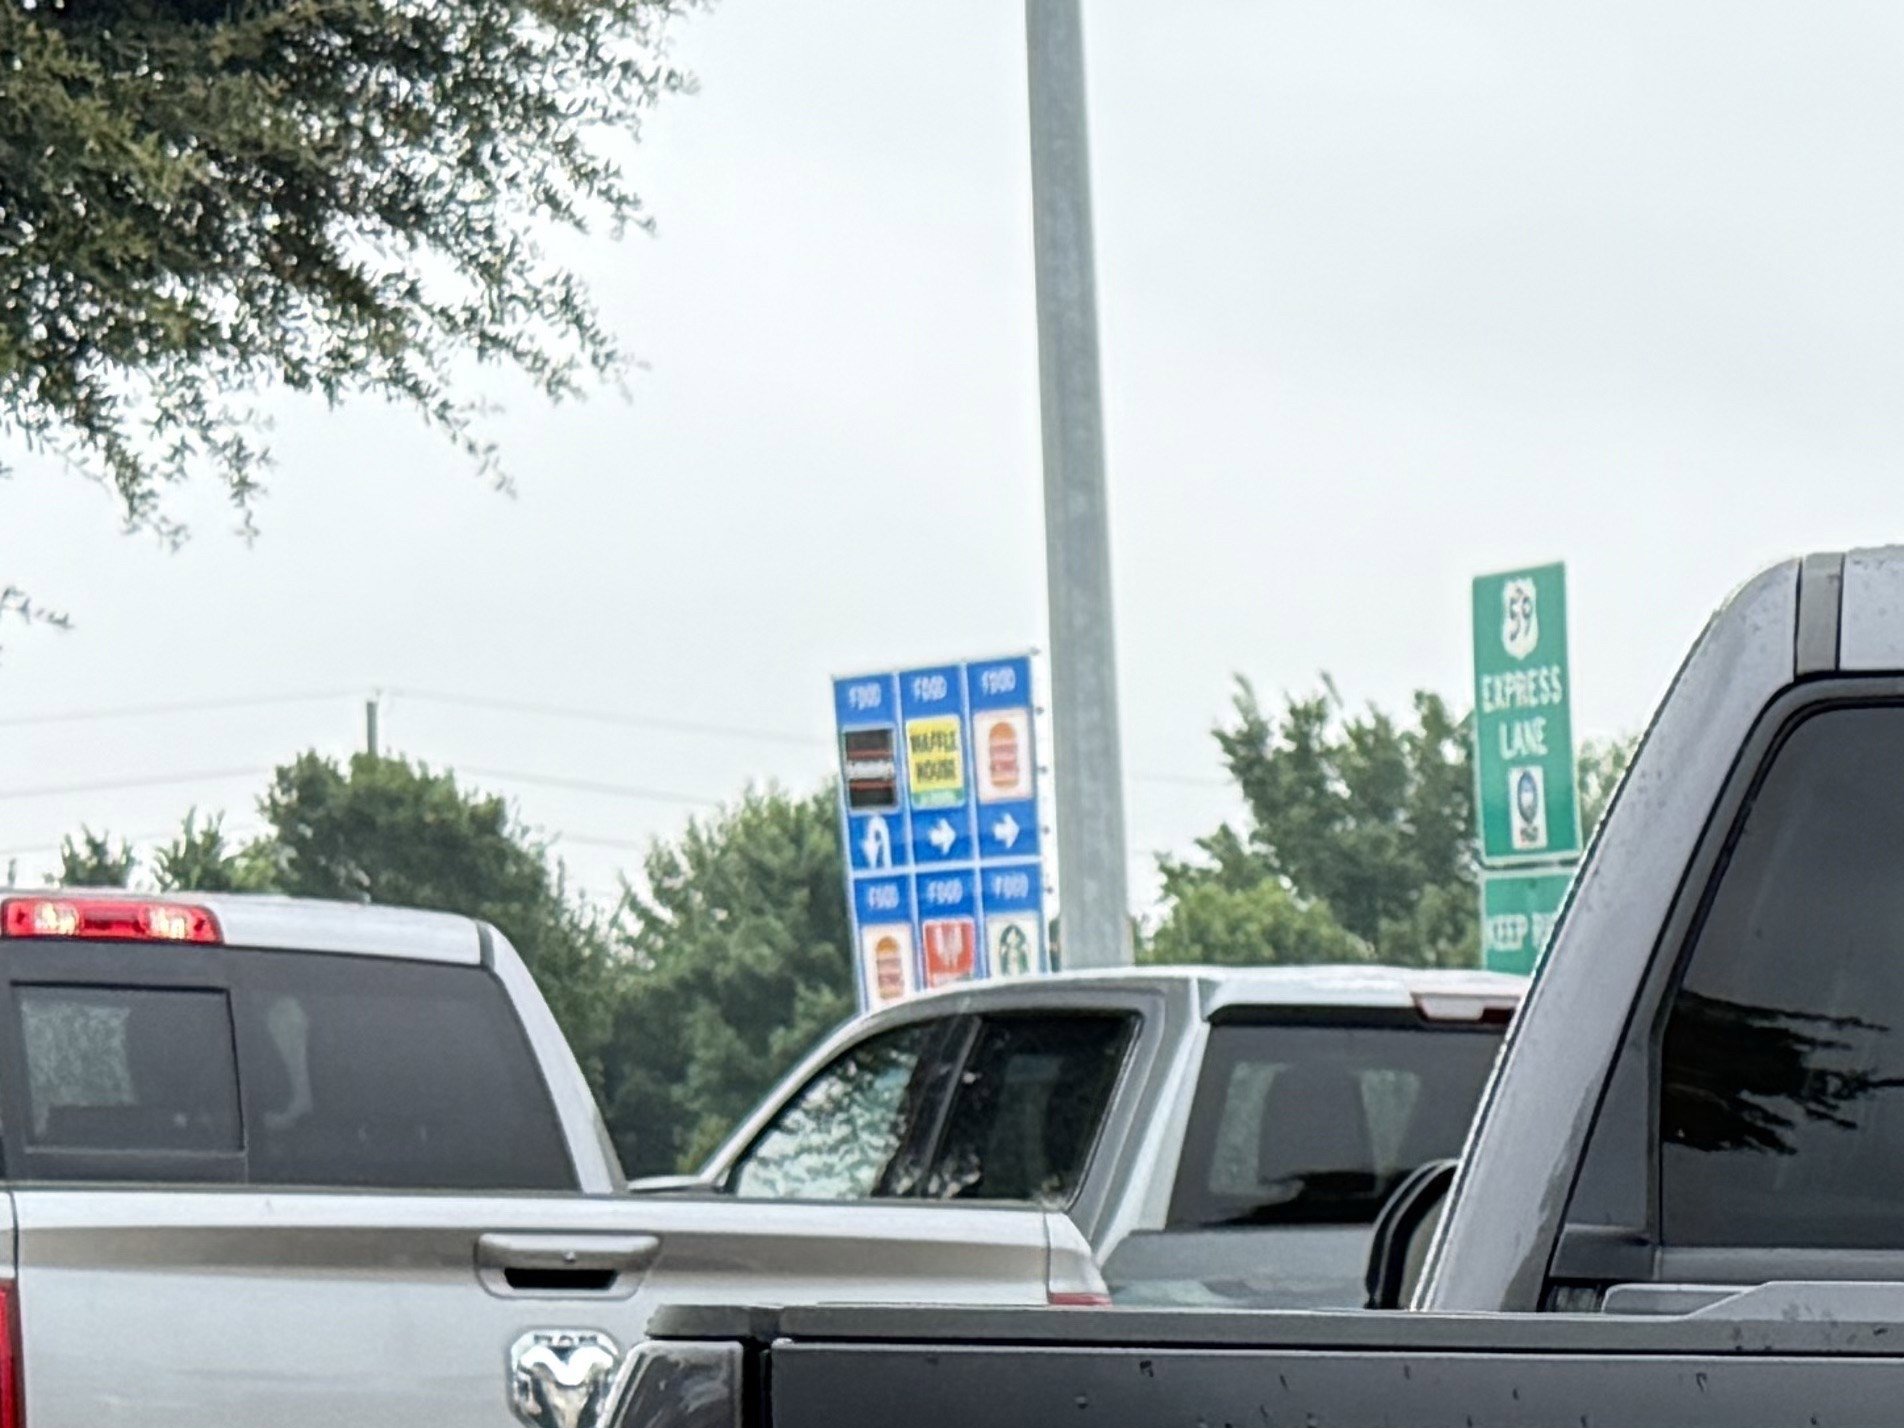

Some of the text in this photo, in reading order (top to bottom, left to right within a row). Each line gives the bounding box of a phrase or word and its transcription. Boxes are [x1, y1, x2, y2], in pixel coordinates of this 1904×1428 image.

[1509, 595, 1533, 643] 59
[913, 675, 947, 702] FOOD
[981, 666, 1016, 695] FOOD
[1480, 665, 1563, 715] EXPRESS
[848, 683, 882, 709] FOOD
[910, 730, 956, 754] WAFFLE
[1500, 716, 1548, 761] LANE
